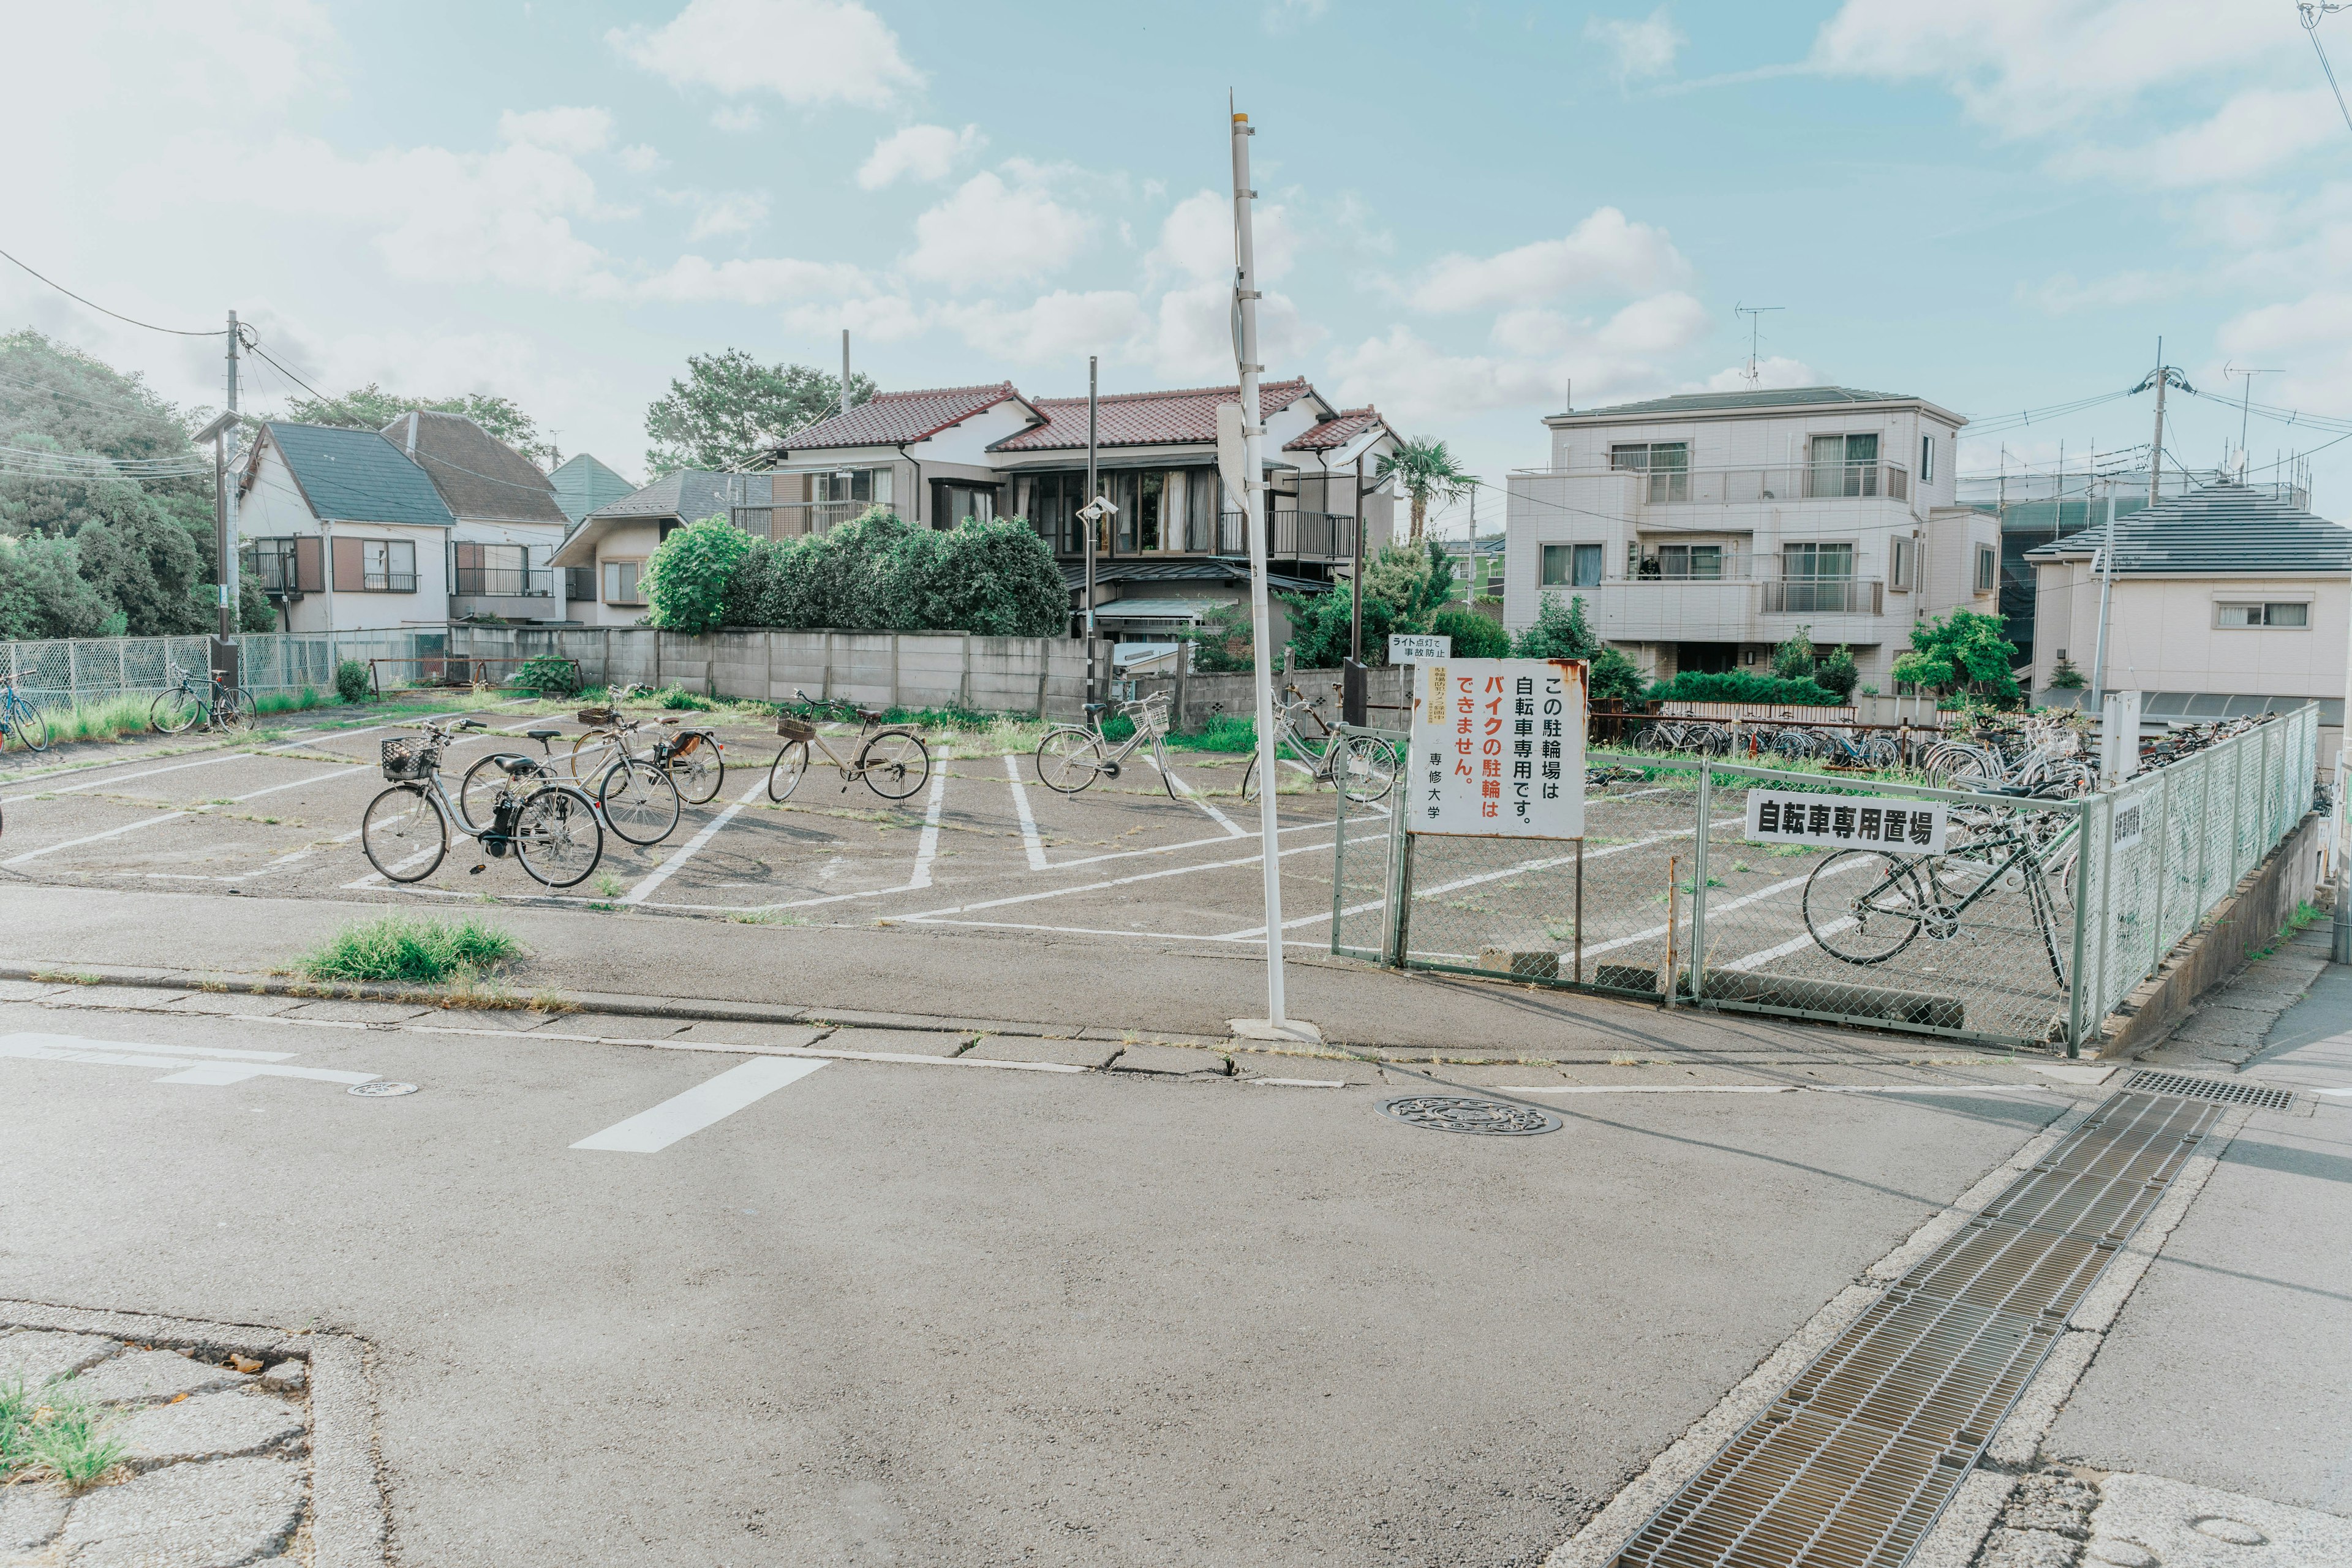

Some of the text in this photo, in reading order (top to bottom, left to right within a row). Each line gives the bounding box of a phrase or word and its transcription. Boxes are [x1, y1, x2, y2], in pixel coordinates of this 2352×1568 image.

[1393, 638, 1440, 647] ライト点灯で
[1404, 648, 1445, 658] 事故防止
[1434, 667, 1446, 720] 駐輪場防犯カメラ録画中
[1454, 677, 1474, 785] できません。
[1482, 676, 1504, 818] バイクの駐輪は
[1513, 676, 1533, 824] 自転車専用です。
[1542, 677, 1562, 799] この駐輪場は
[1428, 752, 1442, 819] 専修大学
[1758, 799, 1933, 845] 自転車専用置場
